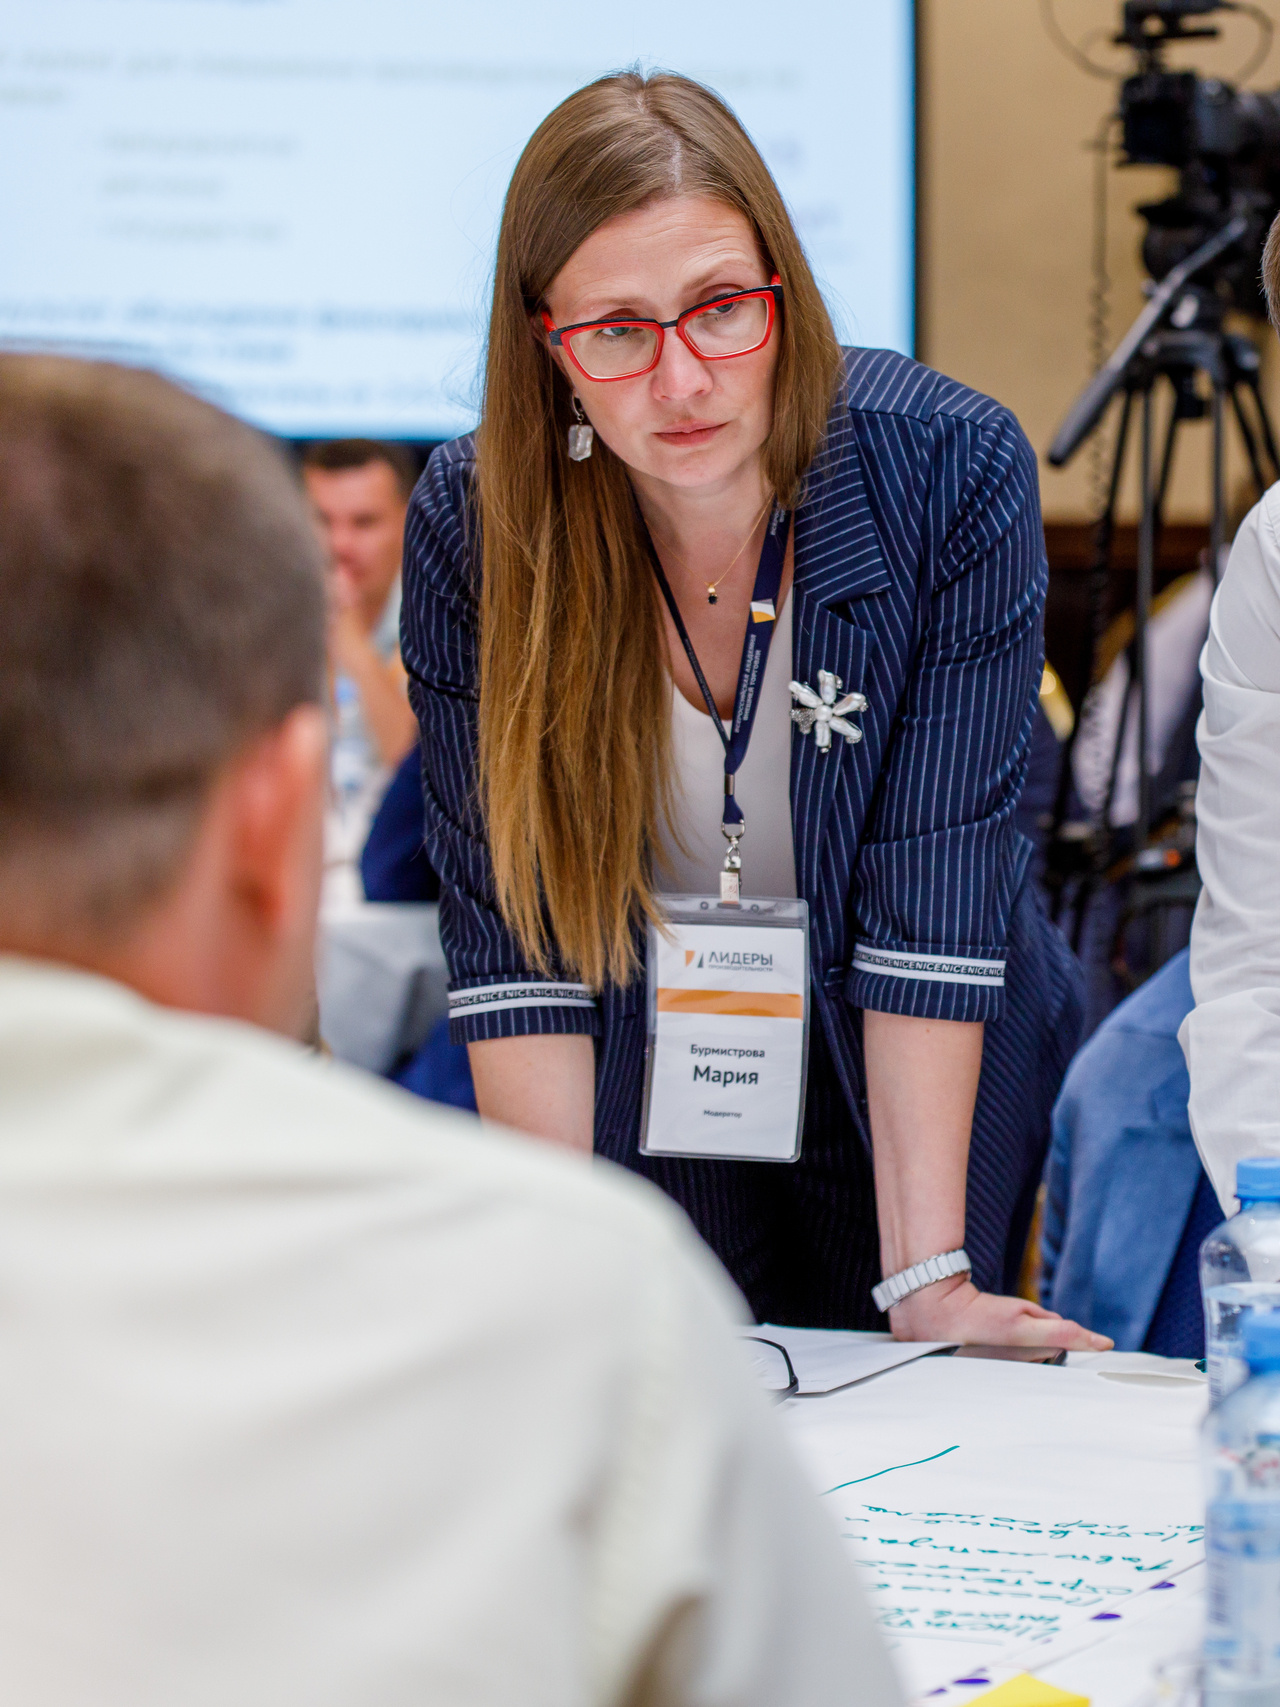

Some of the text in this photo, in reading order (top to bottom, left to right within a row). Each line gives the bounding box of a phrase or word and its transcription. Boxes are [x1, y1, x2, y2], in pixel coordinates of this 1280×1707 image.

[708, 951, 773, 966] ЛИДЕРЫ
[690, 1044, 766, 1058] Бурмистрова
[693, 1065, 759, 1088] Мария
[703, 1110, 742, 1119] Модератор
